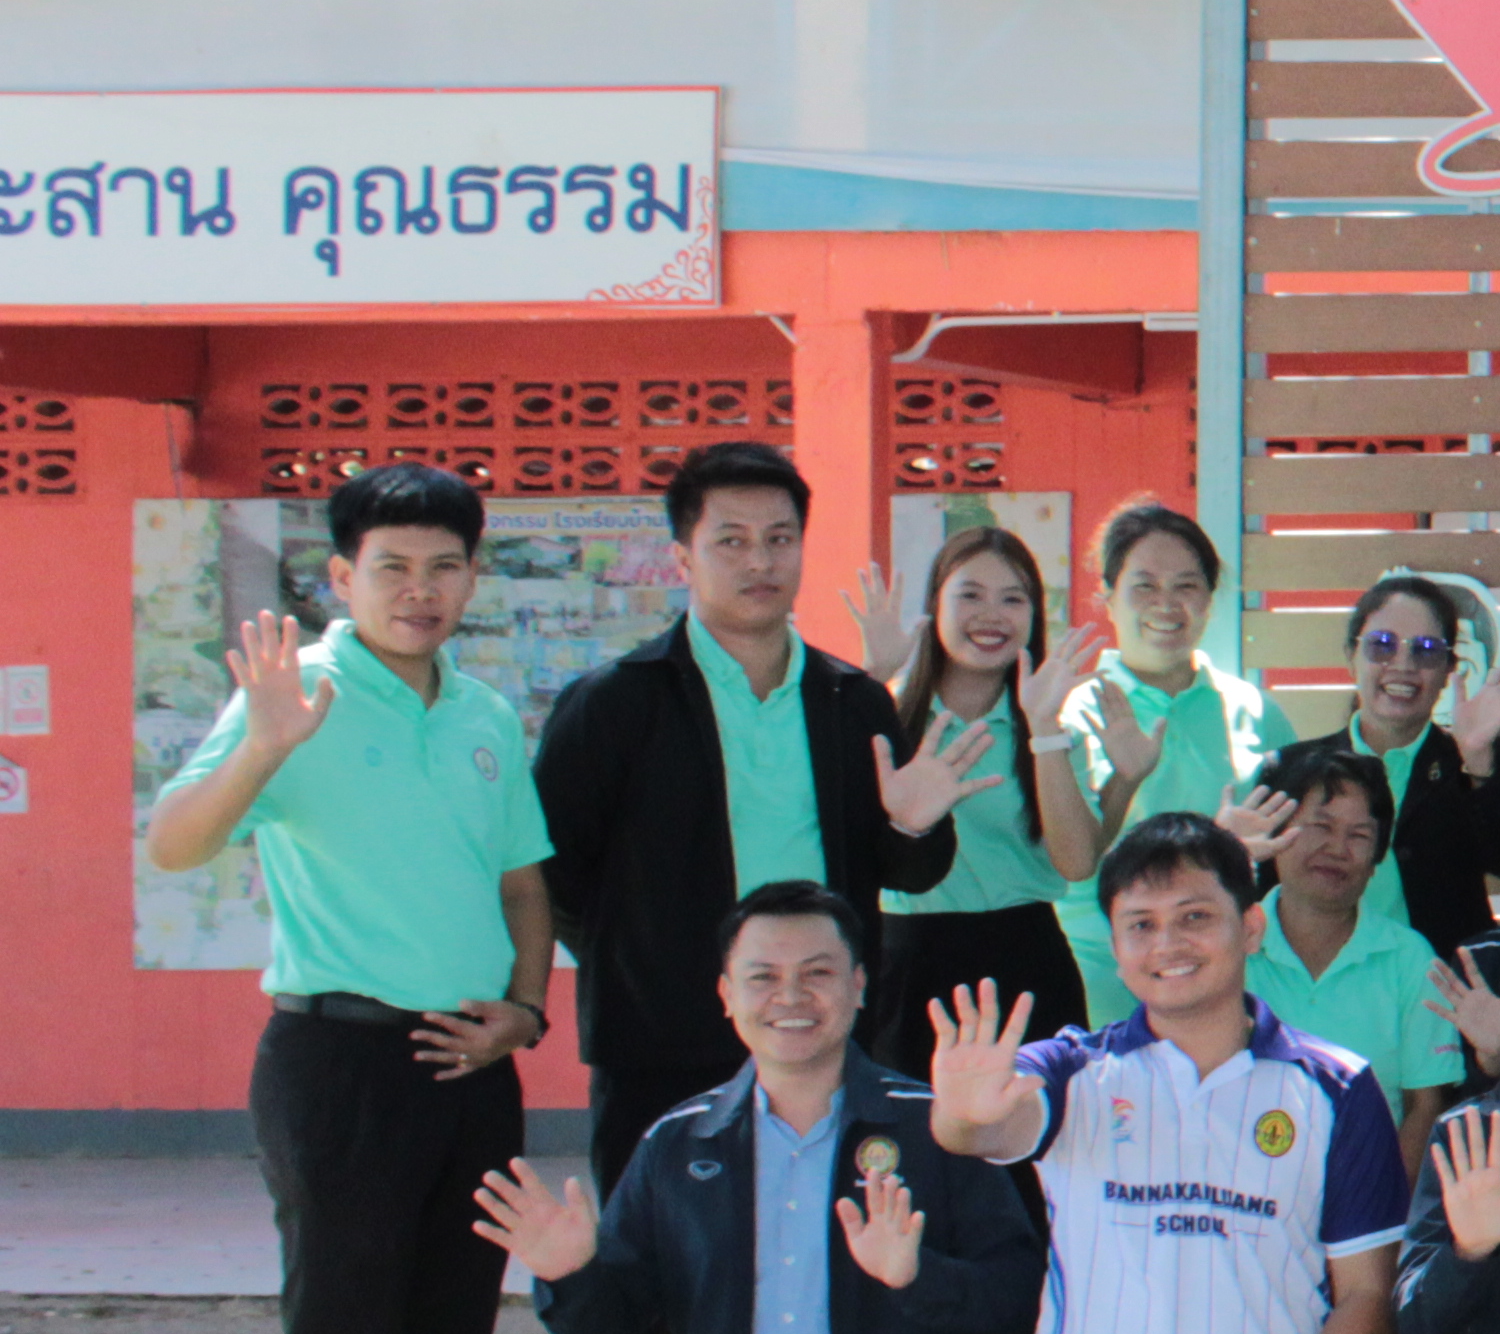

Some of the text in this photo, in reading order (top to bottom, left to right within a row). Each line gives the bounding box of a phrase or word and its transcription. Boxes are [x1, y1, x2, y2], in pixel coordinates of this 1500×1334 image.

[283, 163, 692, 276] คุณธรรม
[489, 515, 547, 529] จกรรม
